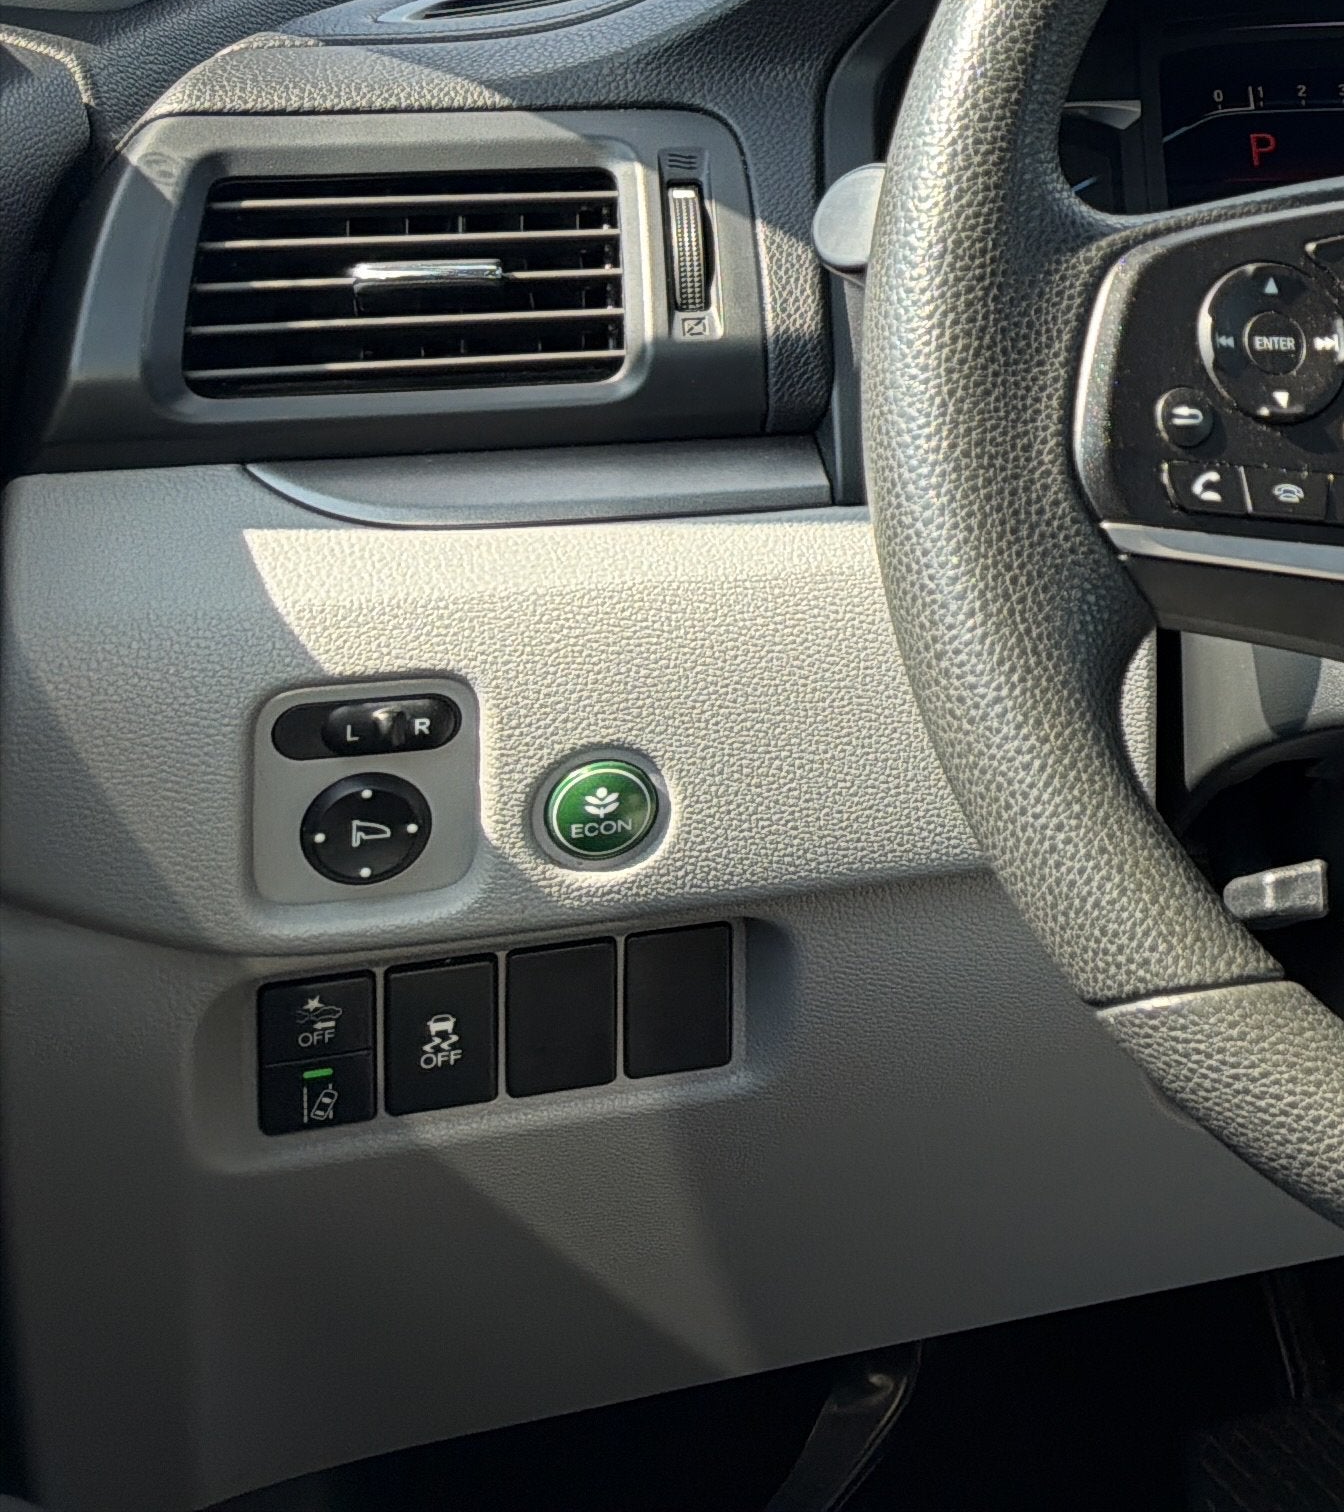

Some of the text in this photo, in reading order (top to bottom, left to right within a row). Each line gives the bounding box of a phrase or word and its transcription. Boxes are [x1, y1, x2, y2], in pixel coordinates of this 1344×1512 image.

[1213, 89, 1224, 103] 0
[1257, 86, 1265, 98] 1
[1297, 85, 1307, 97] 2
[1249, 133, 1277, 168] P
[1254, 337, 1296, 352] ENTER
[346, 718, 431, 743] L R
[570, 817, 633, 840] ECON
[298, 1029, 336, 1048] OFF
[419, 1049, 463, 1071] OFF
